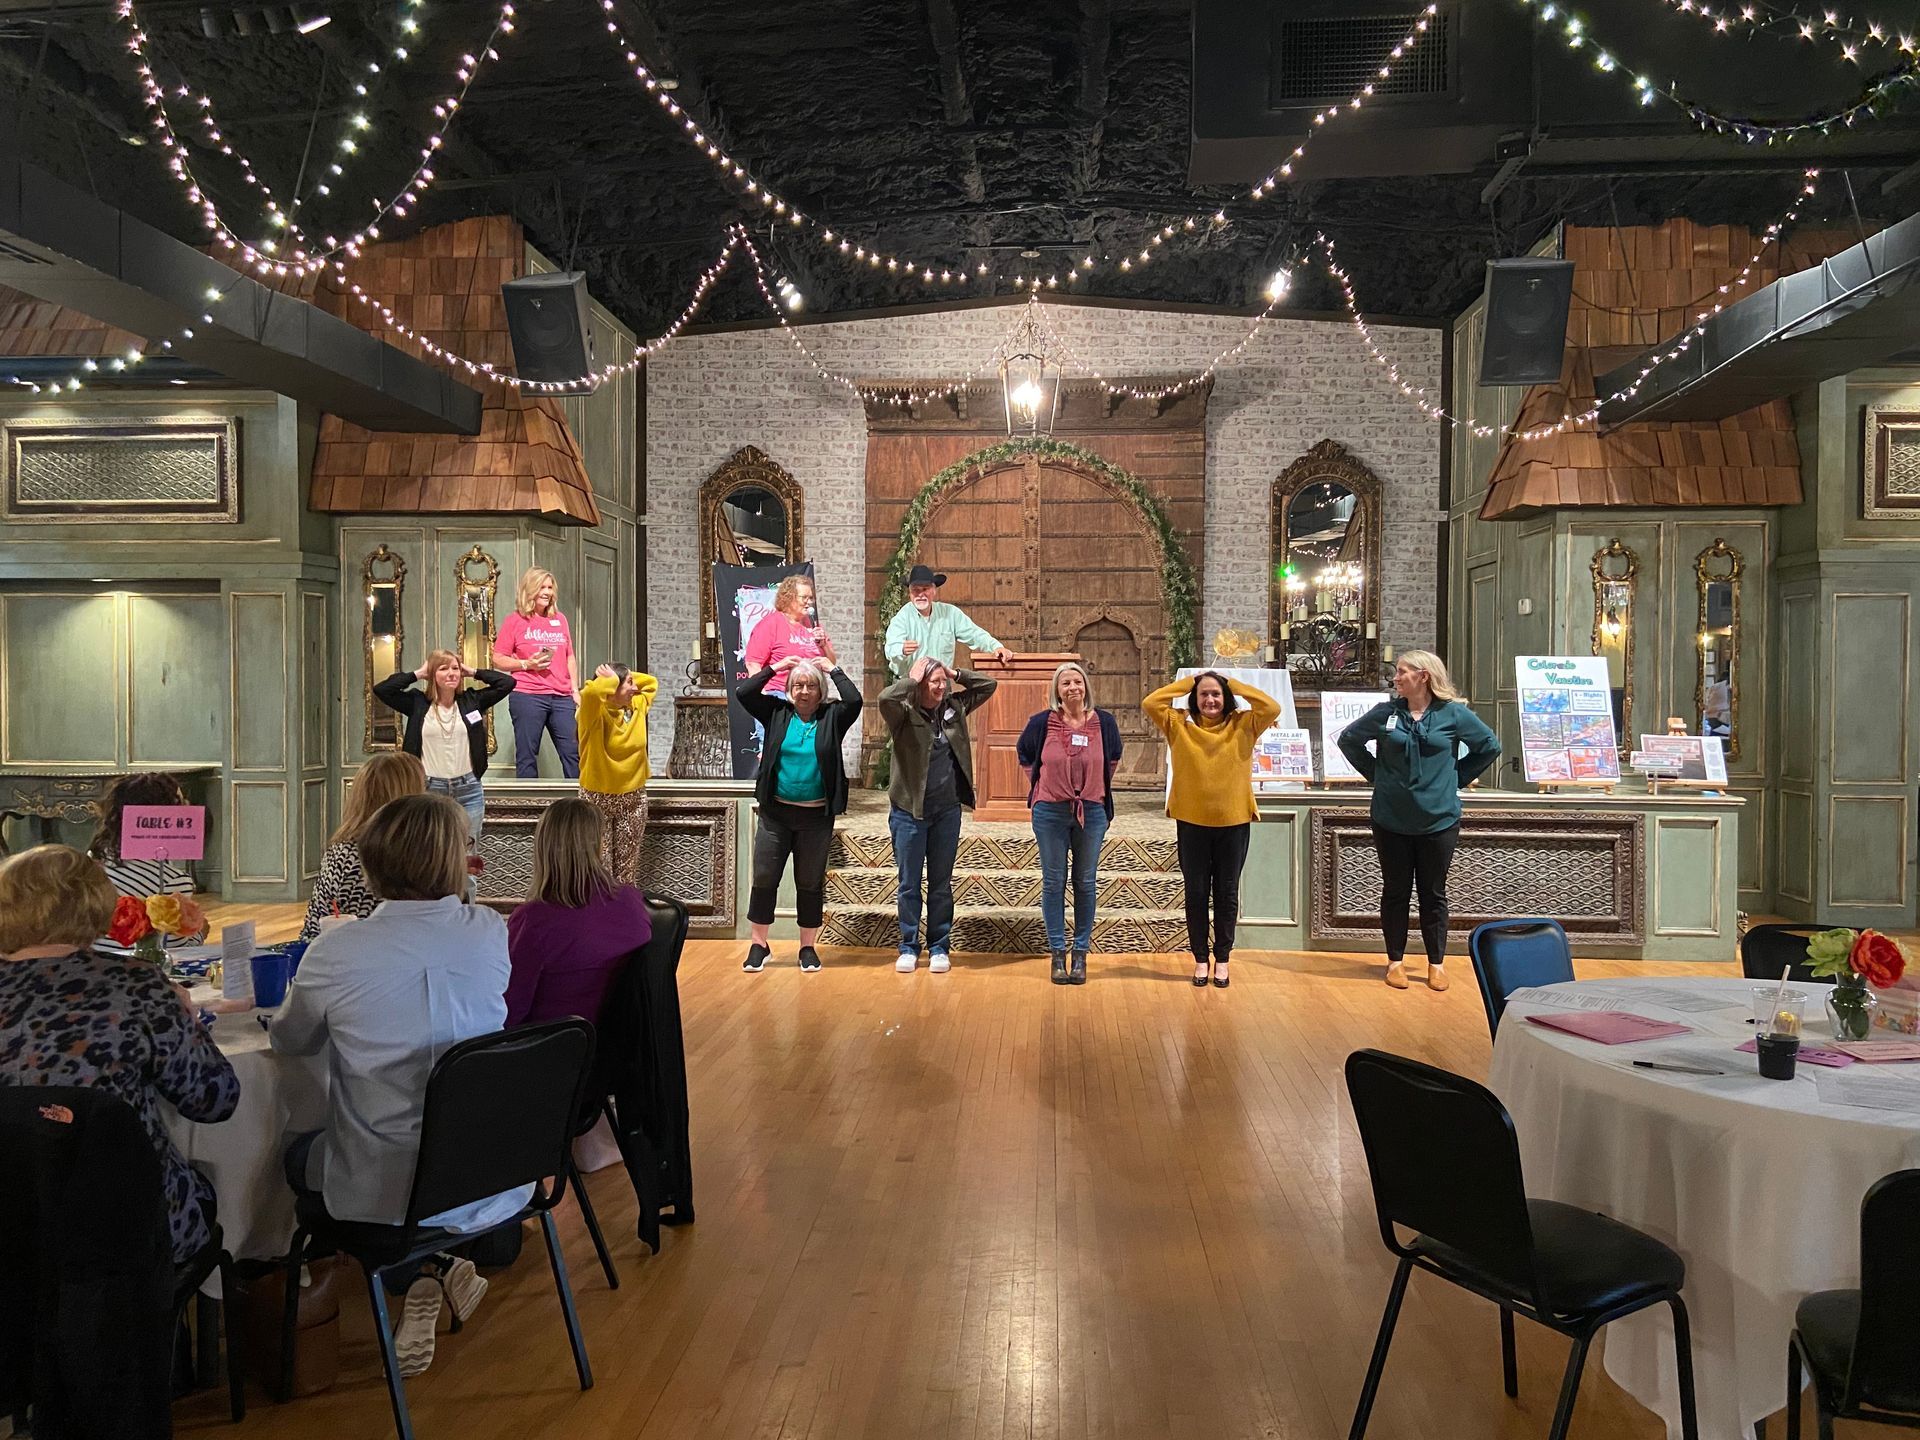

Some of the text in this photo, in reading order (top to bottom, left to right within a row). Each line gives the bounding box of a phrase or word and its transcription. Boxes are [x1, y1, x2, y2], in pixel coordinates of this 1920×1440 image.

[1528, 658, 1576, 671] Colorado
[1545, 672, 1593, 686] Vacation
[136, 816, 193, 829] TABLE #3
